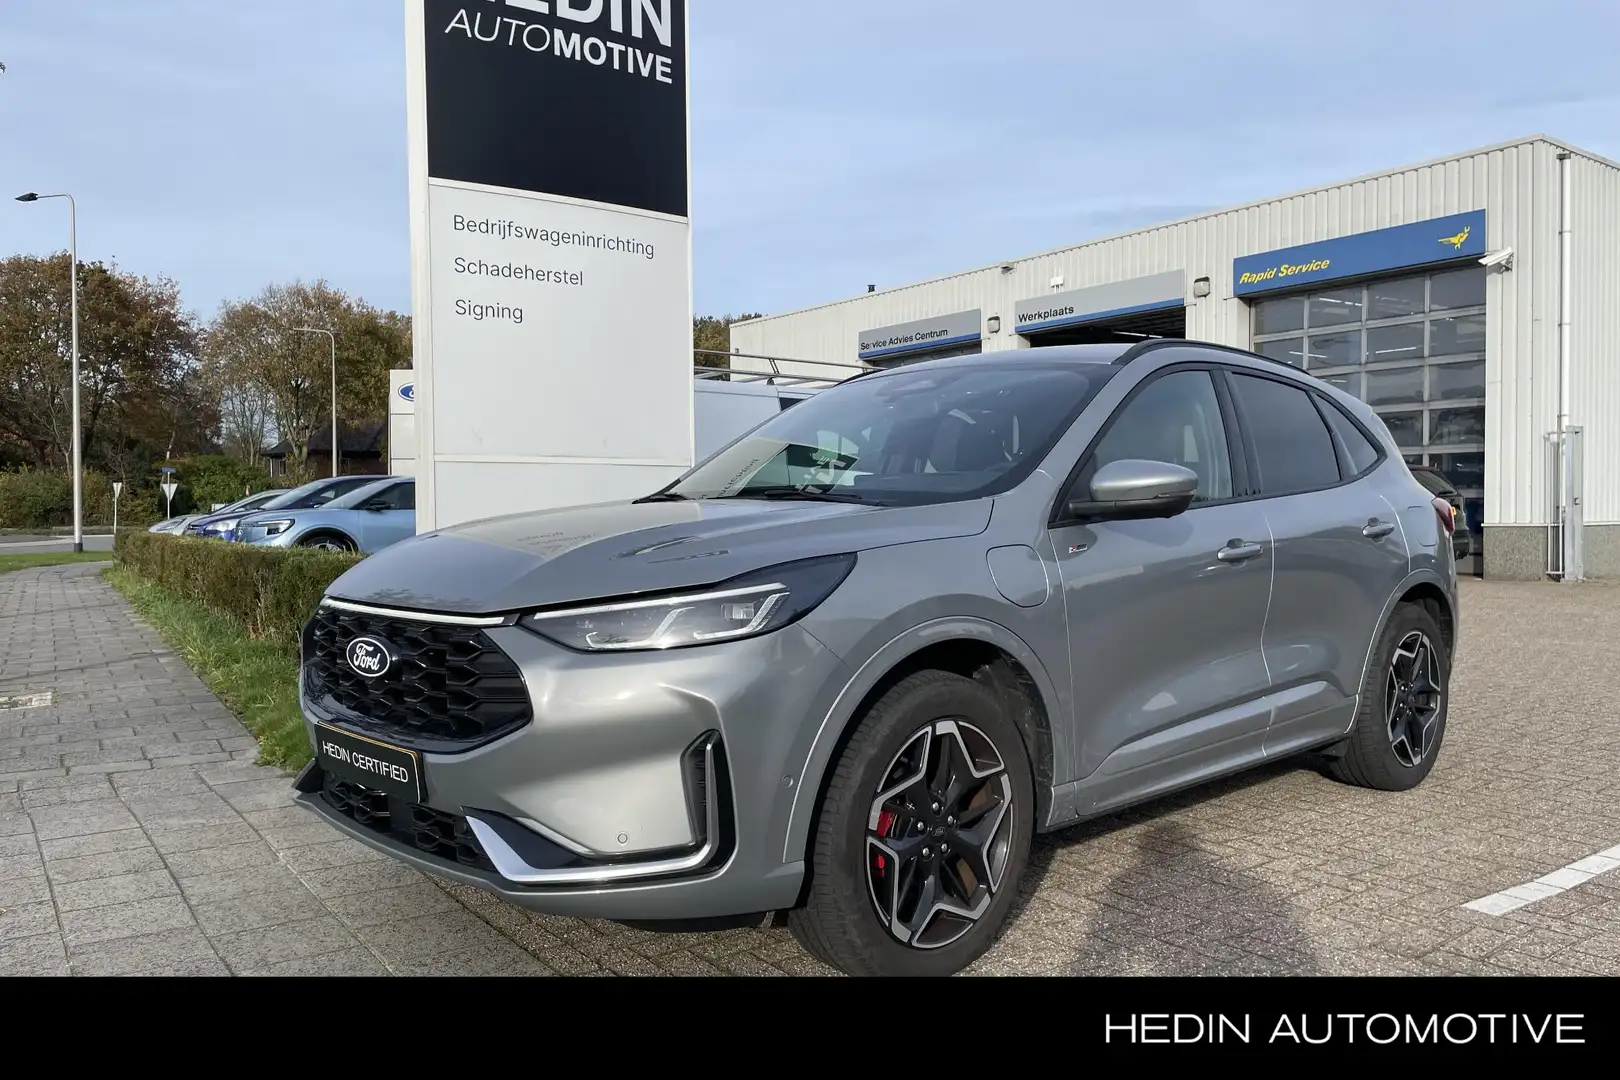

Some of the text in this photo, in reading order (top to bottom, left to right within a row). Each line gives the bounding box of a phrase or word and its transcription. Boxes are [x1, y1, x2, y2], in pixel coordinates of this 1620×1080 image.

[444, 8, 673, 84] AUTOMOTIVE
[453, 215, 655, 260] Bedrijfswageninrichting
[454, 257, 584, 286] Schadeherstel
[1239, 259, 1330, 284] Rapid Service
[454, 299, 524, 324] Signing
[1018, 306, 1075, 323] Werkplaats
[860, 328, 948, 351] Sevice Advies Centrum
[353, 642, 381, 671] Ford
[322, 740, 409, 783] HEDIN CERTIFIED
